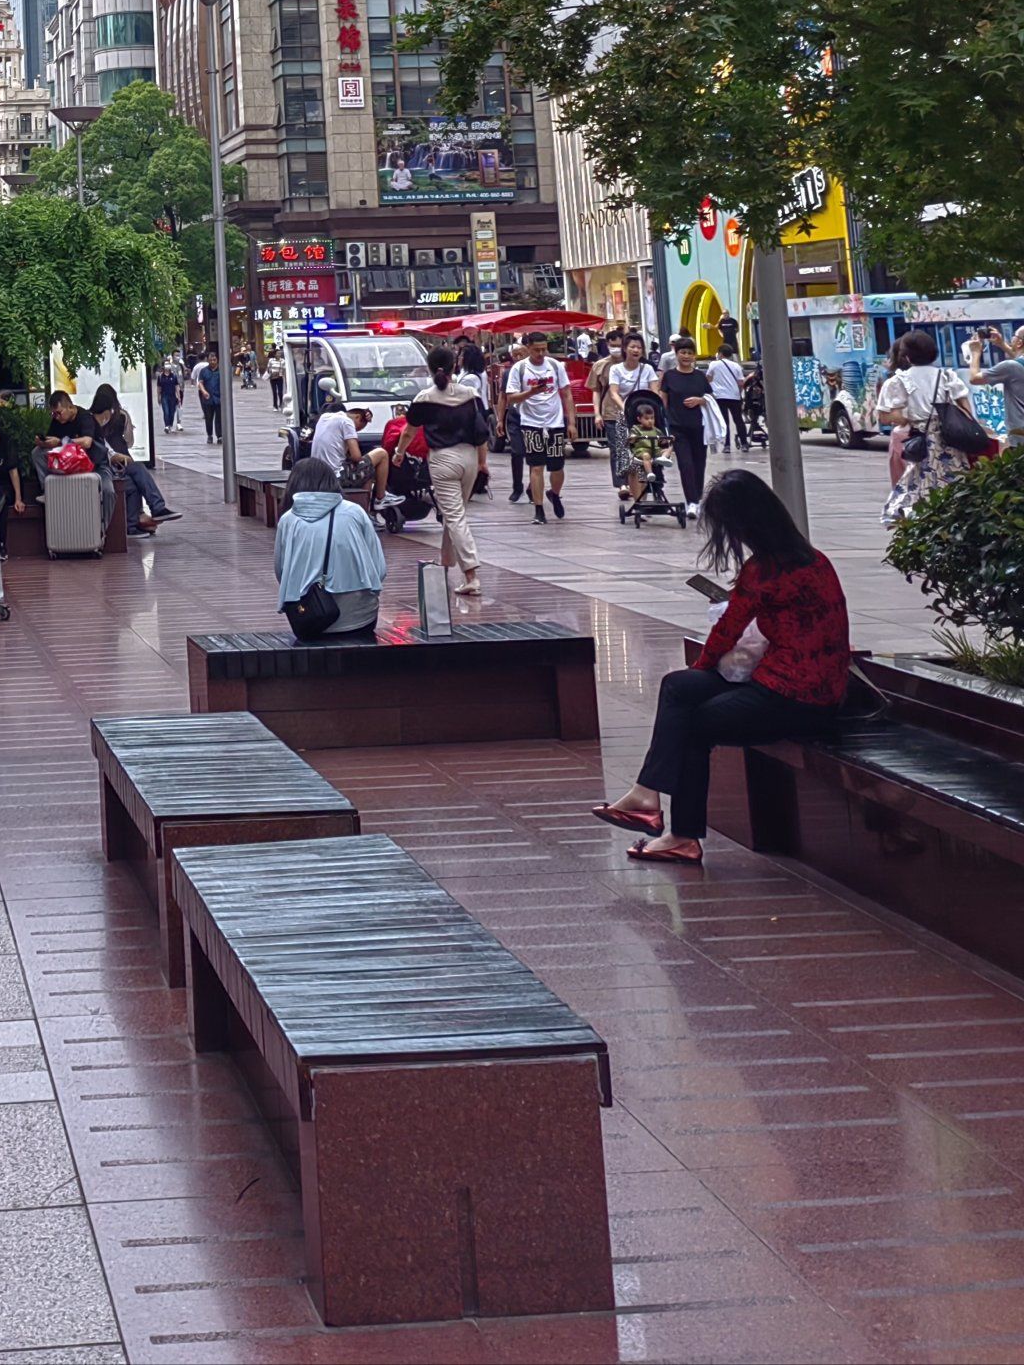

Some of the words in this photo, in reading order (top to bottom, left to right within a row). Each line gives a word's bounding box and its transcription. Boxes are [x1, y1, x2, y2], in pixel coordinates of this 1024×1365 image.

[579, 208, 627, 232] PANDORA
[261, 245, 325, 262] 汤包馆
[267, 279, 319, 292] 新雅食品
[417, 292, 463, 304] SUBWAY
